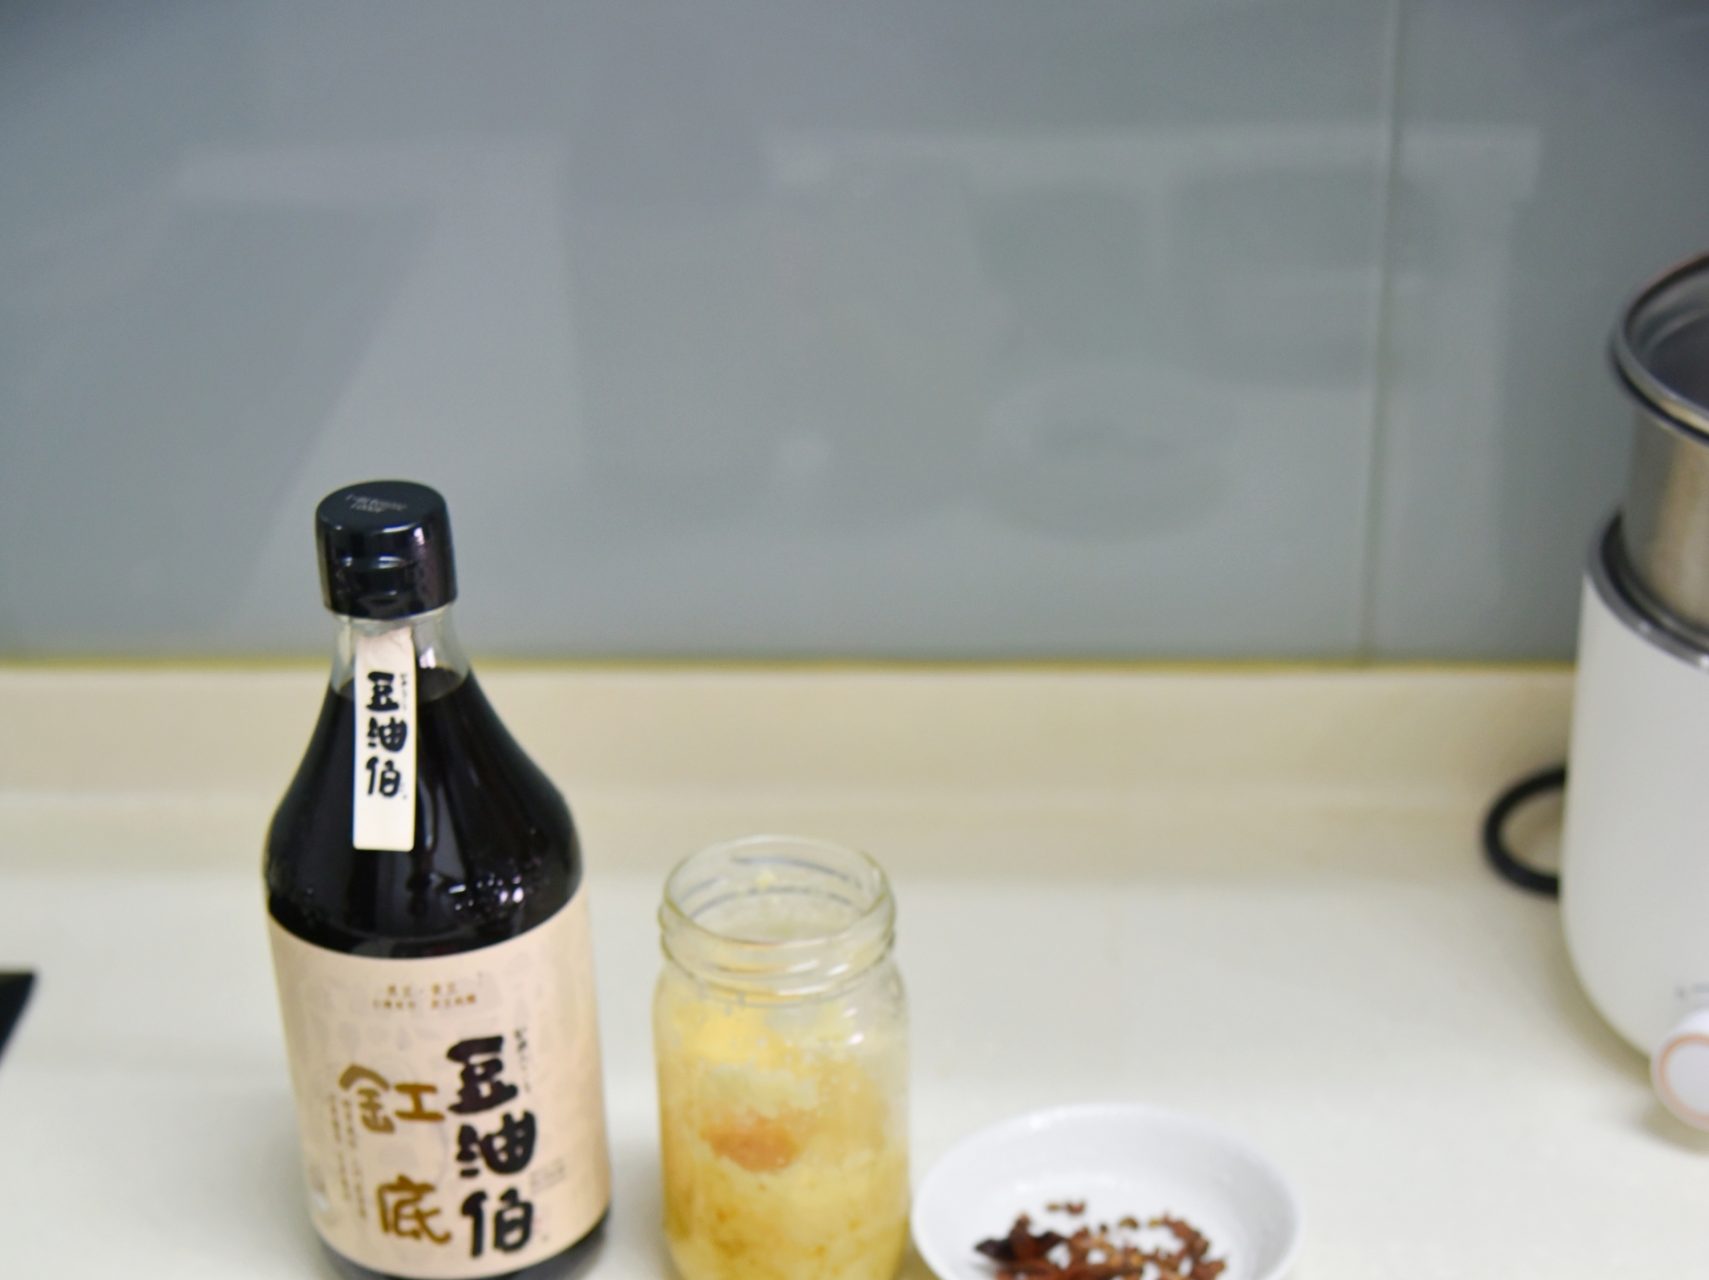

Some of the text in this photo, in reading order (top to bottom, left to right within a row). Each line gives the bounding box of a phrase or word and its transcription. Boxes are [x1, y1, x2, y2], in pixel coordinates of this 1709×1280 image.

[366, 671, 407, 798] 豆油伯
[446, 1035, 536, 1258] 豆油伯
